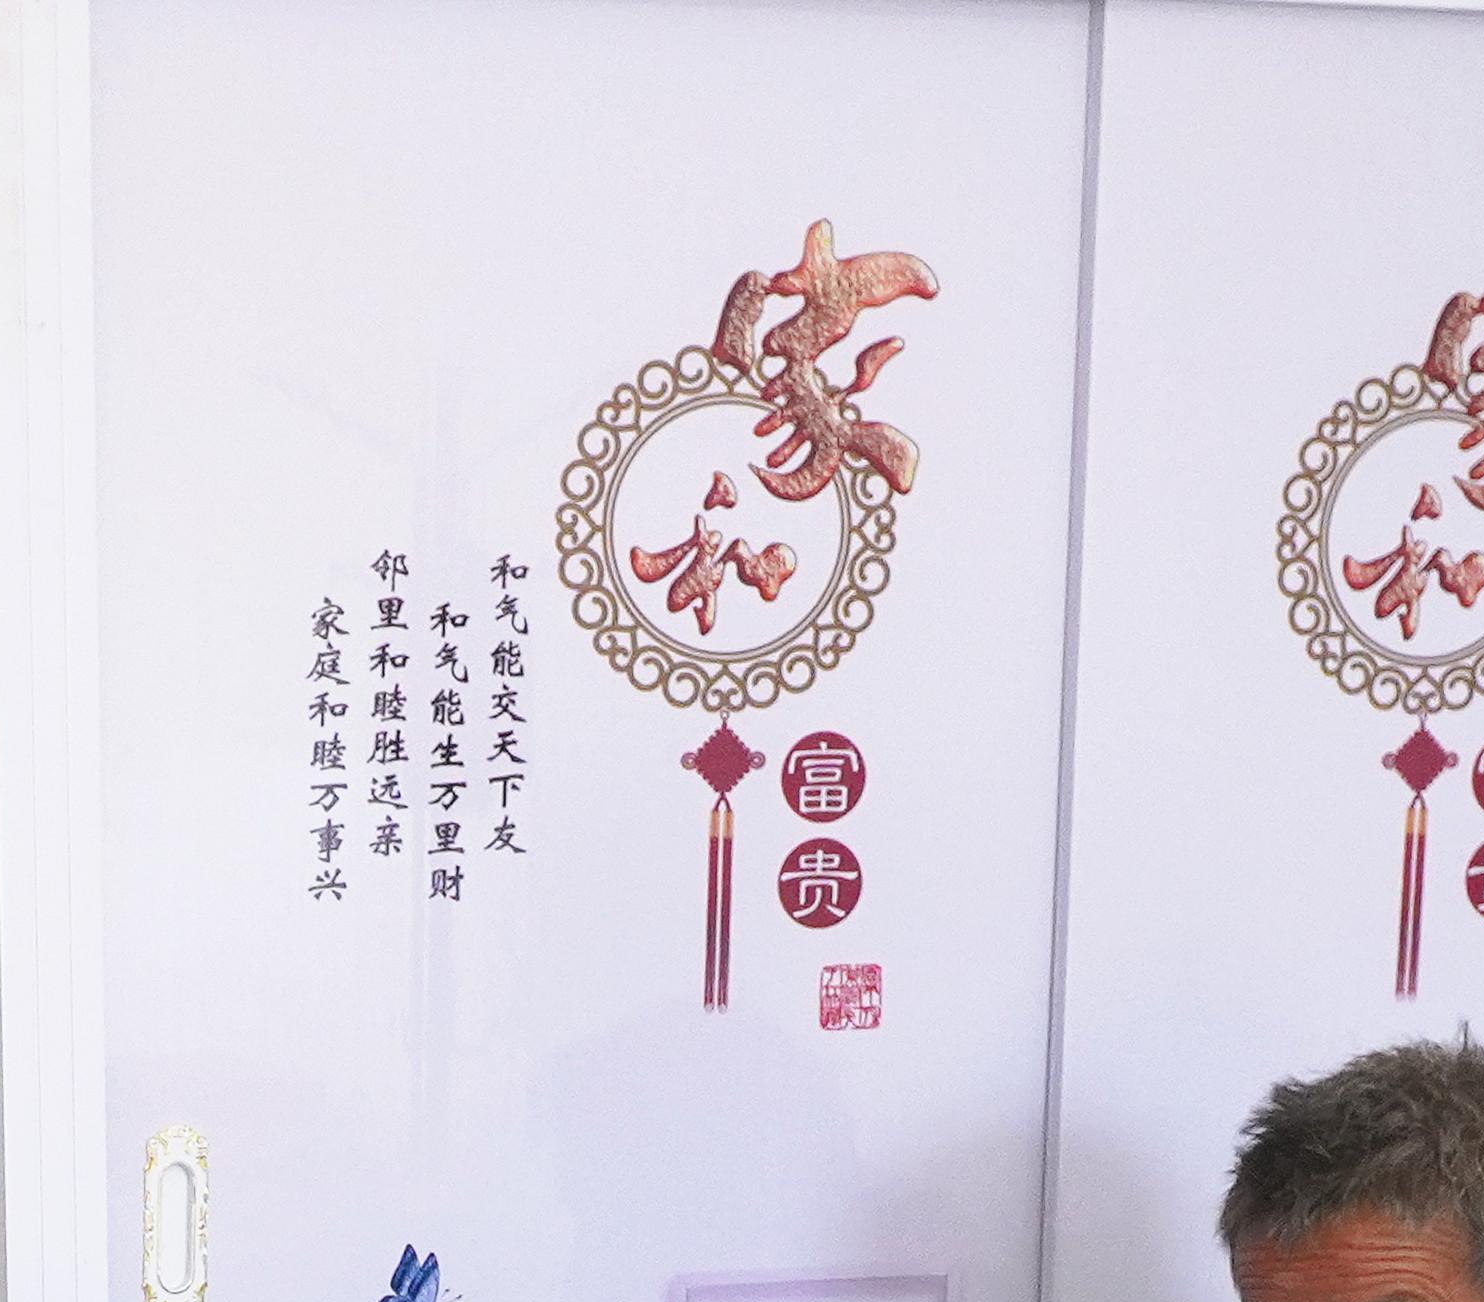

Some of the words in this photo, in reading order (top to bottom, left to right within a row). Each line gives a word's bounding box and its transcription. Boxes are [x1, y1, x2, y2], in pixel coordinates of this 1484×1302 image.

[305, 596, 351, 901] 家庭和睦万事兴
[366, 548, 411, 857] 邻里和睦胜远亲
[427, 601, 471, 902] 和气能生万里财
[483, 553, 530, 854] 和气能交天下友
[780, 735, 864, 925] 富贵
